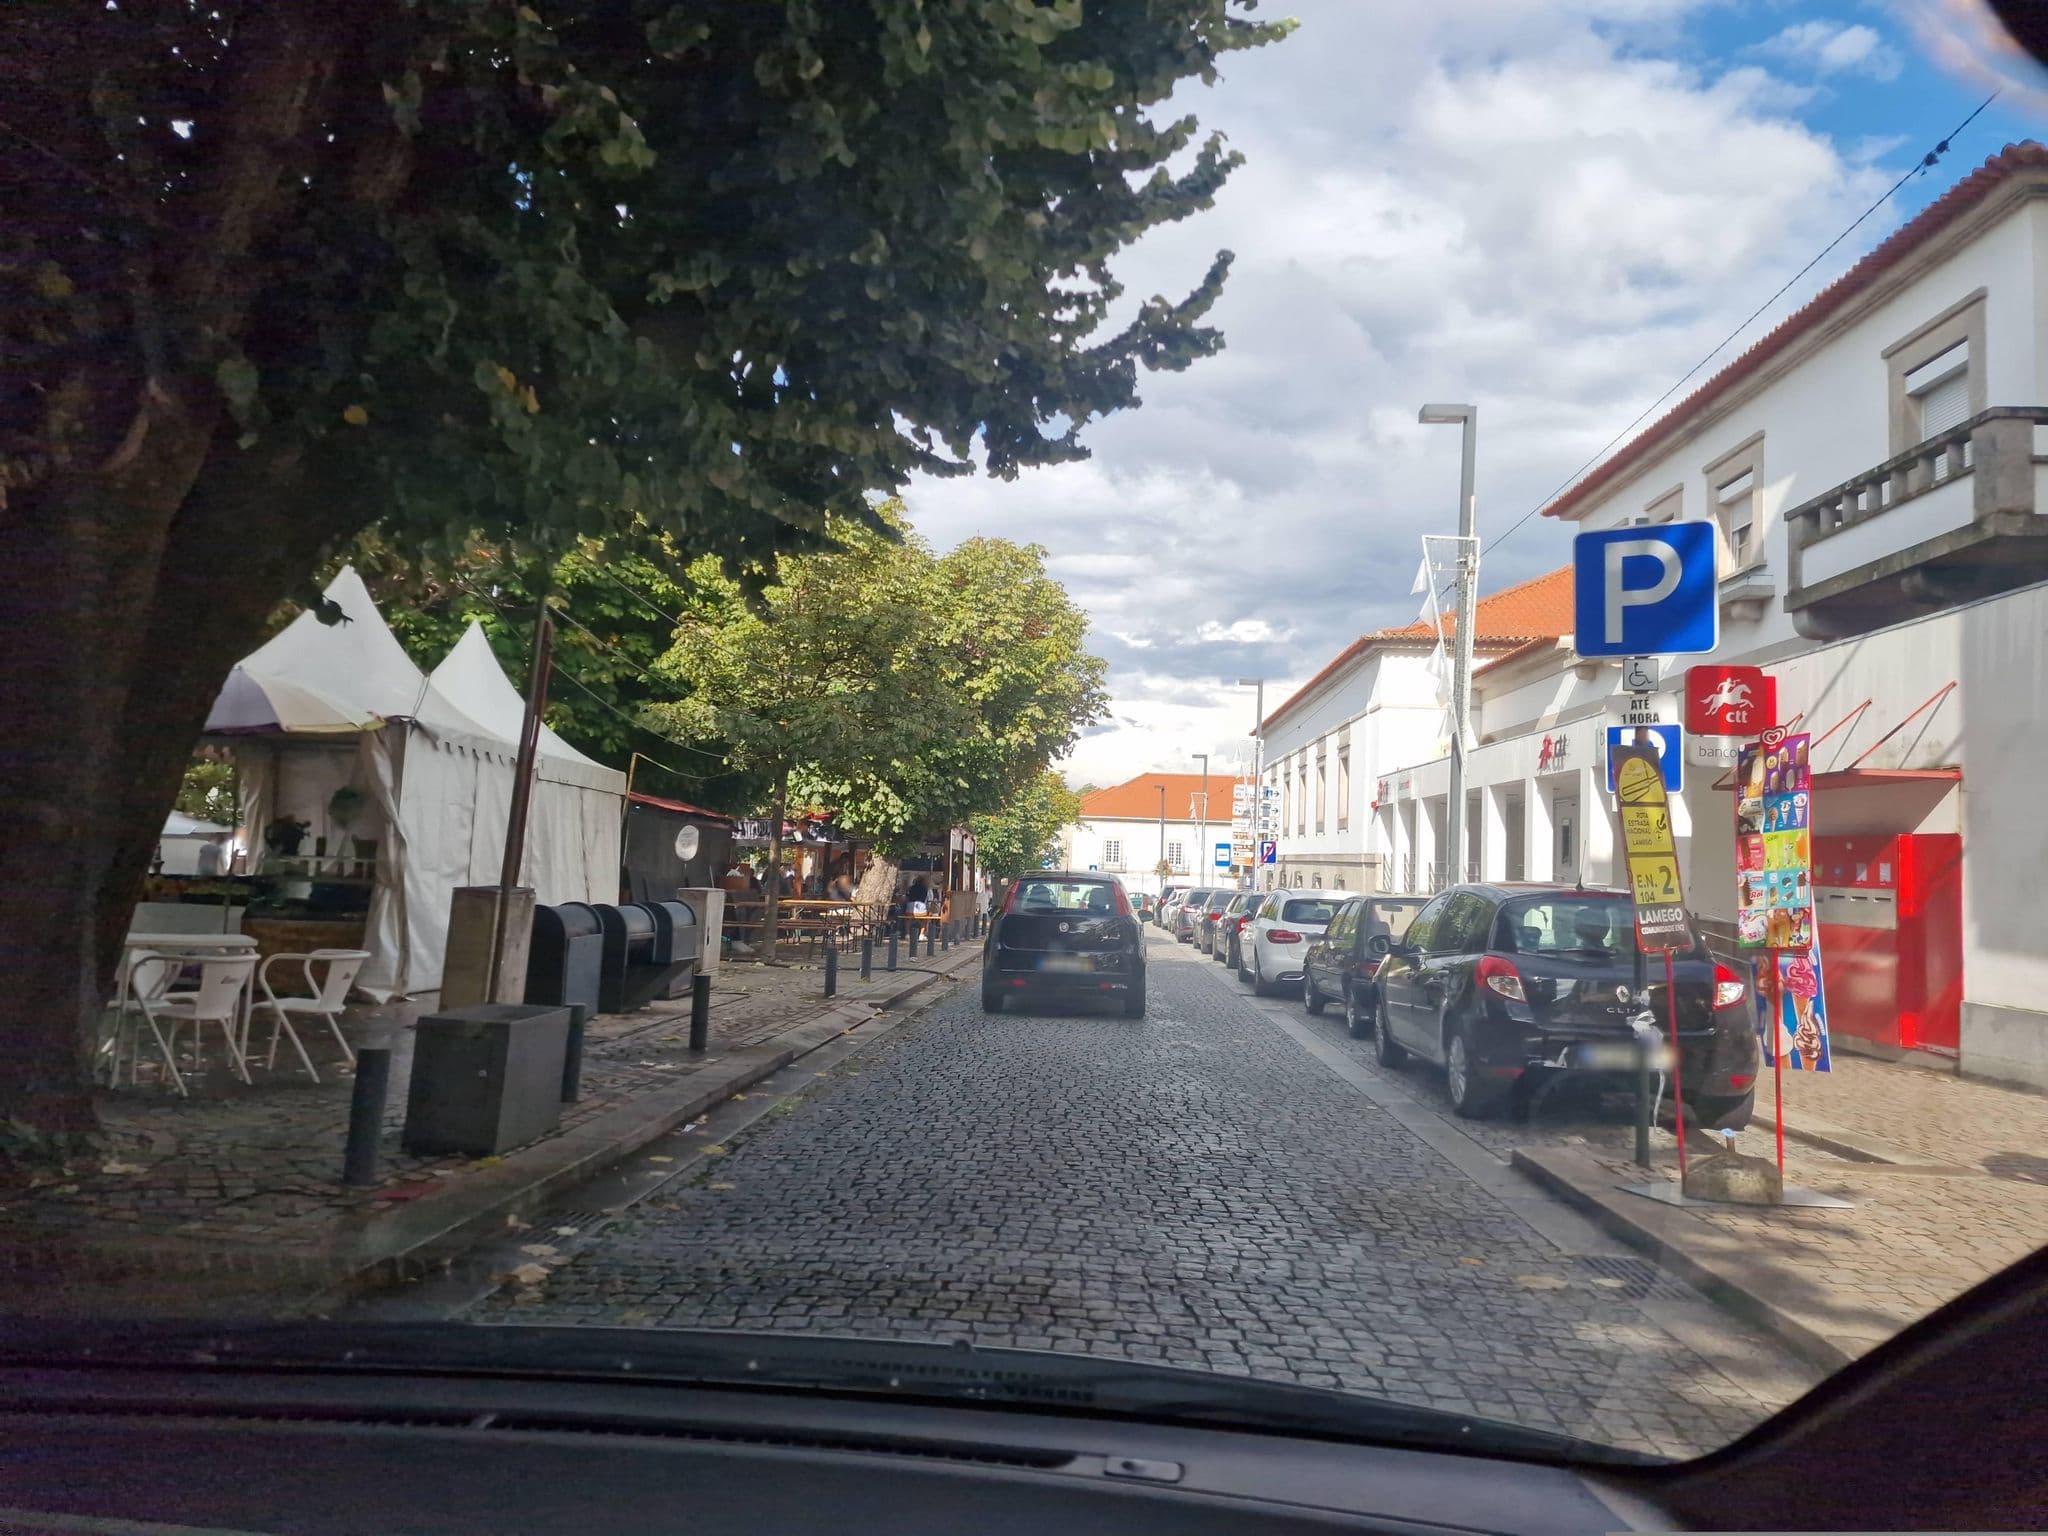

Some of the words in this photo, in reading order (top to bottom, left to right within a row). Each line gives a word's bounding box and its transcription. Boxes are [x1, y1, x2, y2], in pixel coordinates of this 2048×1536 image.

[1604, 539, 1683, 644] P
[1630, 696, 1650, 710] ATÉ
[1621, 714, 1627, 724] 1
[1629, 713, 1660, 724] HORA
[1725, 710, 1749, 723] ctt
[1699, 746, 1738, 757] banco
[1636, 874, 1658, 888] E.N.
[1657, 865, 1675, 895] 2
[1640, 891, 1656, 902] 104
[1638, 907, 1683, 925] LAMEGO
